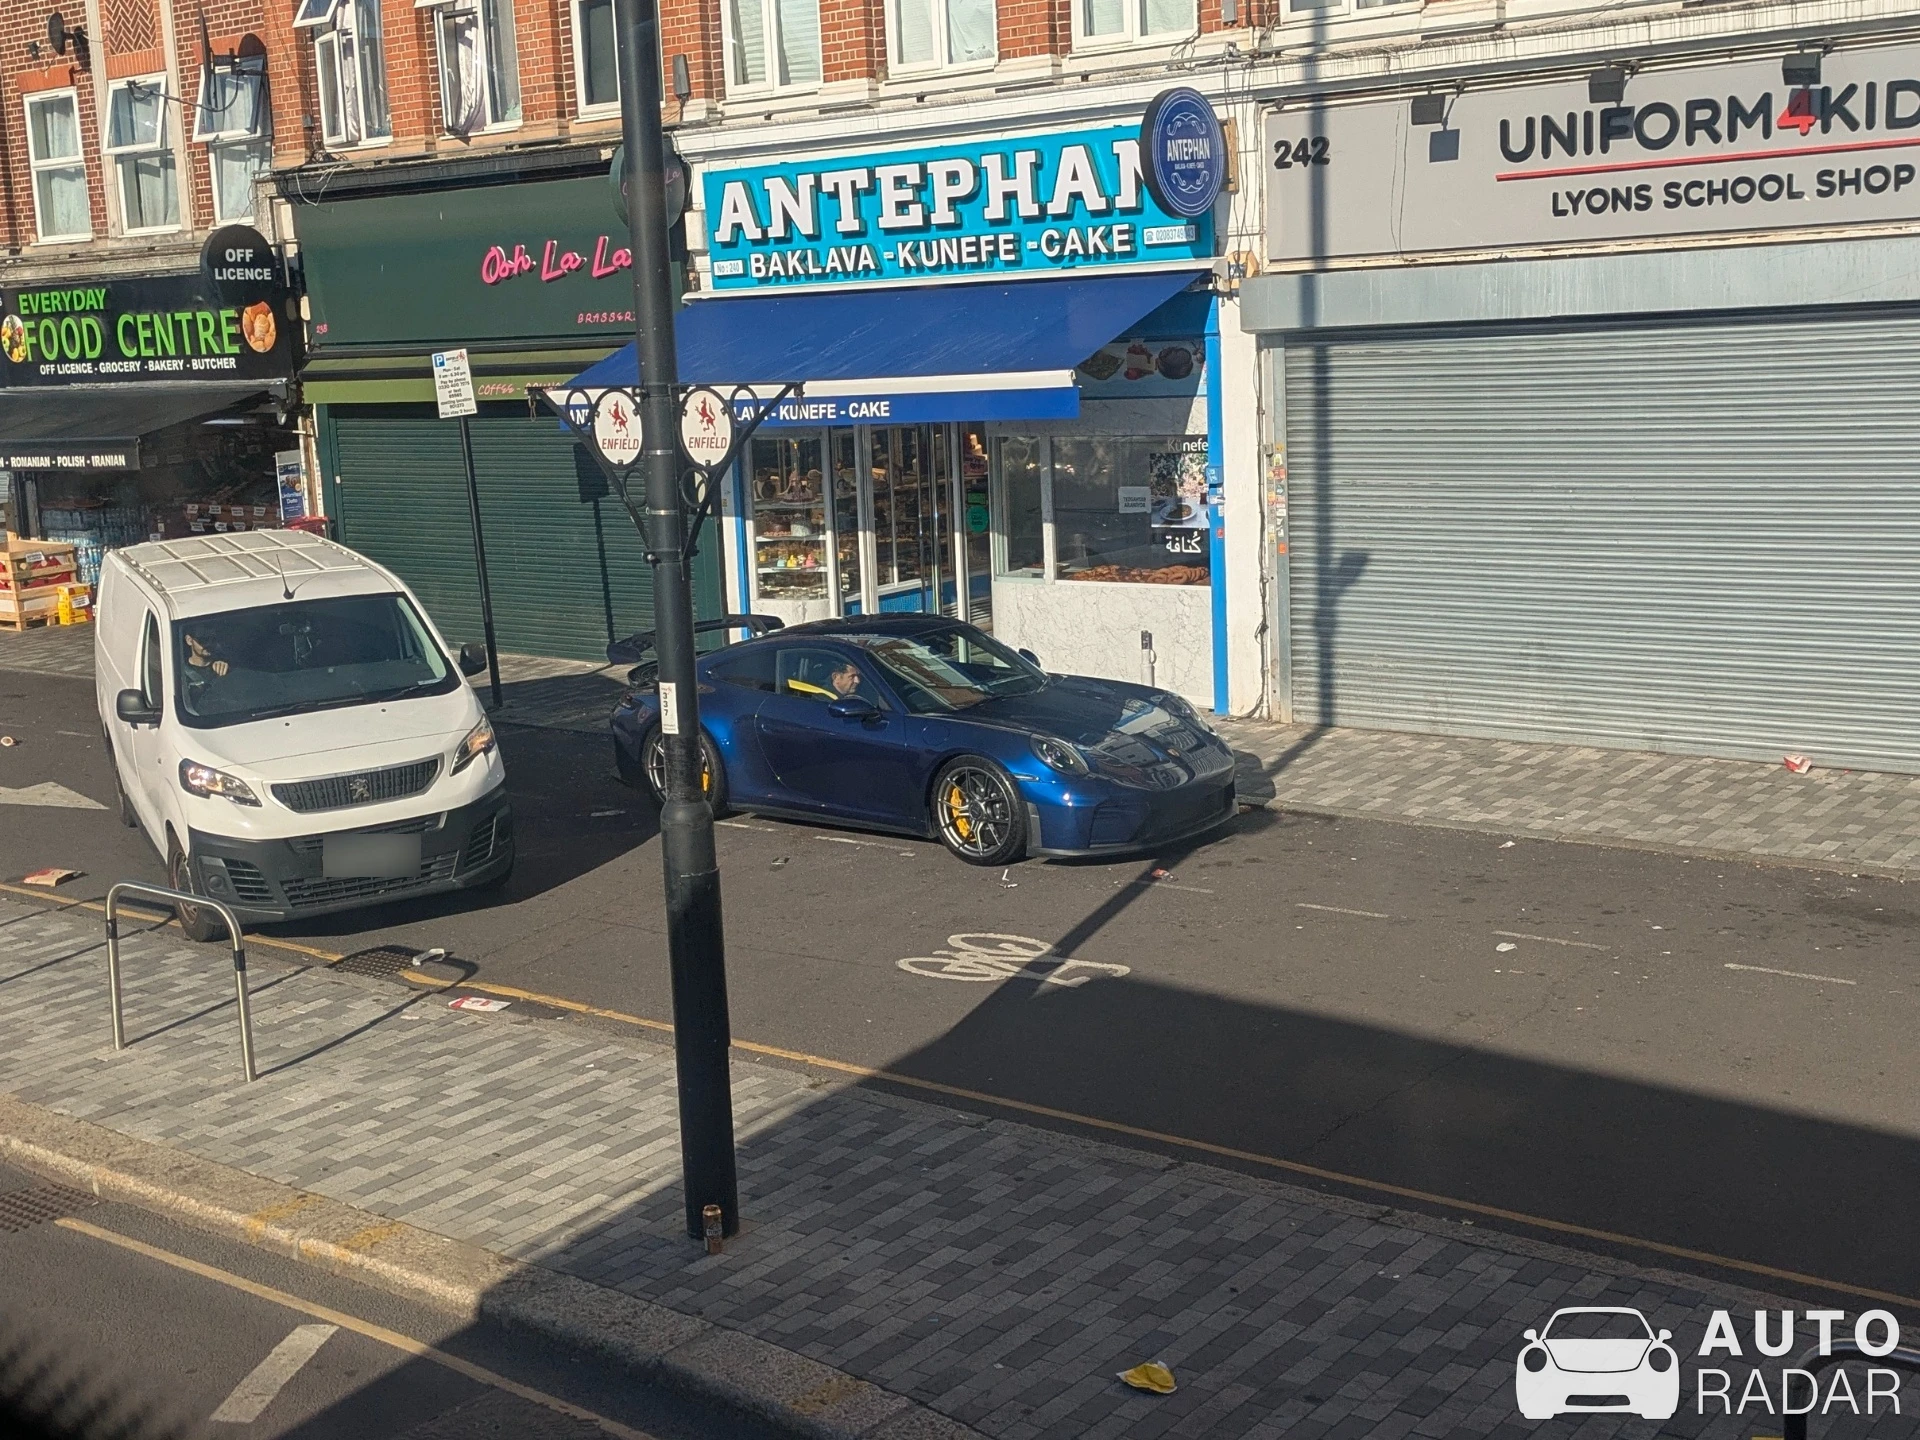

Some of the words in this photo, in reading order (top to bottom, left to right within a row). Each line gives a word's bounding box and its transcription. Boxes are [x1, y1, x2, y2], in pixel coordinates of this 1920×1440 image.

[1166, 138, 1210, 162] ANTEPHAN
[1273, 136, 1330, 169] 242
[1552, 184, 1653, 217] LYONS
[1662, 173, 1805, 210] SCHOOL
[1815, 163, 1916, 199] SHOP
[225, 248, 253, 263] OFF
[481, 244, 537, 284] Ooh
[541, 239, 587, 282] La
[592, 235, 632, 278] La
[749, 246, 876, 278] BAKLAVA
[214, 267, 272, 281] LICENCE
[18, 288, 106, 315] EVERYDAY
[23, 316, 102, 362] FOOD
[117, 309, 241, 358] CENTRE
[40, 364, 55, 375] OFF
[57, 362, 93, 374] LICENCE
[99, 361, 140, 373] GROCERY
[148, 359, 184, 371] BAKERY
[192, 358, 236, 370] BUTCHER
[779, 404, 836, 420] KUNEFE
[848, 401, 890, 418] CAKE
[601, 438, 639, 450] ENFIELD
[688, 436, 728, 450] ENFIELD
[1167, 438, 1208, 452] Künefe
[10, 456, 50, 468] ROMANIAN
[57, 455, 86, 467] POLISH
[91, 454, 126, 467] IRANIAN
